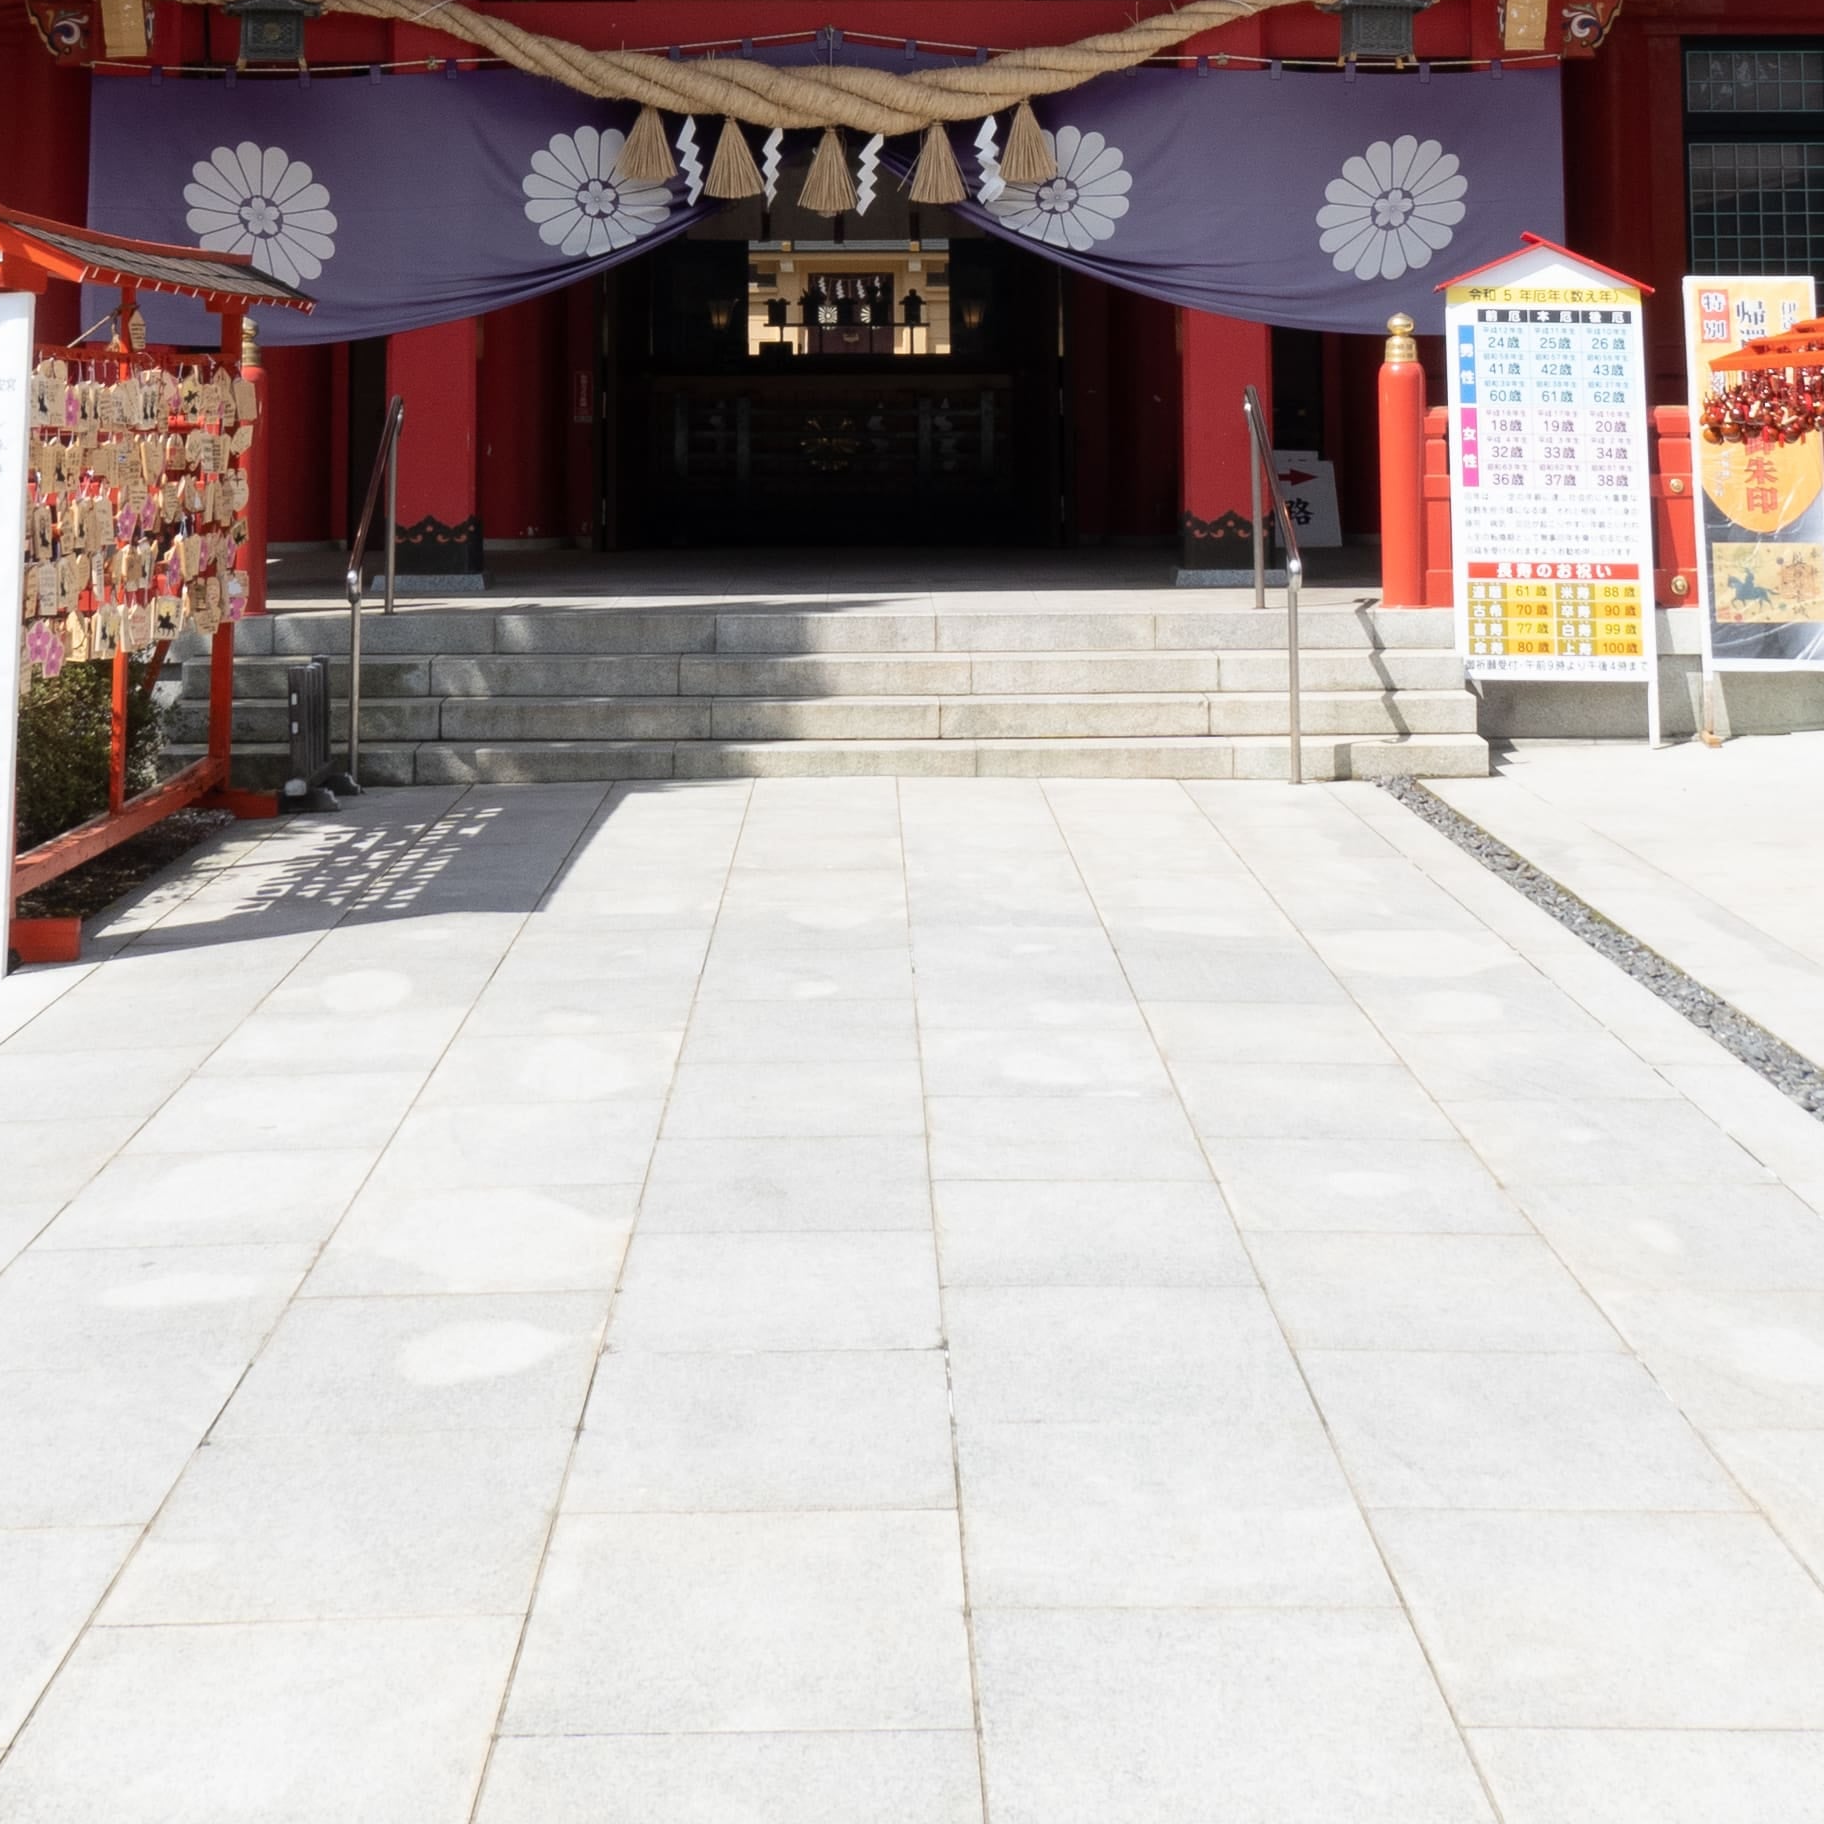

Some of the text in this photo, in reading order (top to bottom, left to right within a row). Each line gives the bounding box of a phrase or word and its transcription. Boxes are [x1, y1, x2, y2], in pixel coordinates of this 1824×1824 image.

[1537, 311, 1572, 323] 本厄
[1702, 293, 1725, 339] 特別
[1487, 336, 1626, 350] 24歳 25歳 26歳
[1460, 342, 1475, 385] 男性
[1489, 363, 1625, 377] 41歳 42歳 43歳
[1489, 390, 1626, 404] 60歳 61歳 62歳
[1491, 419, 1628, 433] 18歳 19歳 20歳
[1462, 426, 1478, 469] 女性
[1491, 445, 1629, 460] 32歳 33歳 34歳
[1492, 472, 1629, 487] 36歳 37歳 38歳
[1497, 562, 1612, 579] 長寿のお祝い
[1515, 584, 1548, 598] 61歳
[1560, 585, 1591, 600] 米寿
[1603, 585, 1636, 599] 88歳
[1516, 603, 1549, 617] 70歳
[1604, 604, 1637, 618] 90歳
[1517, 622, 1549, 636] 77歳
[1563, 623, 1592, 637] 白寿
[1605, 623, 1638, 636] 99歳
[1518, 641, 1550, 655] 80歳
[1563, 641, 1593, 656] 上寿
[1602, 642, 1639, 656] 100歳
